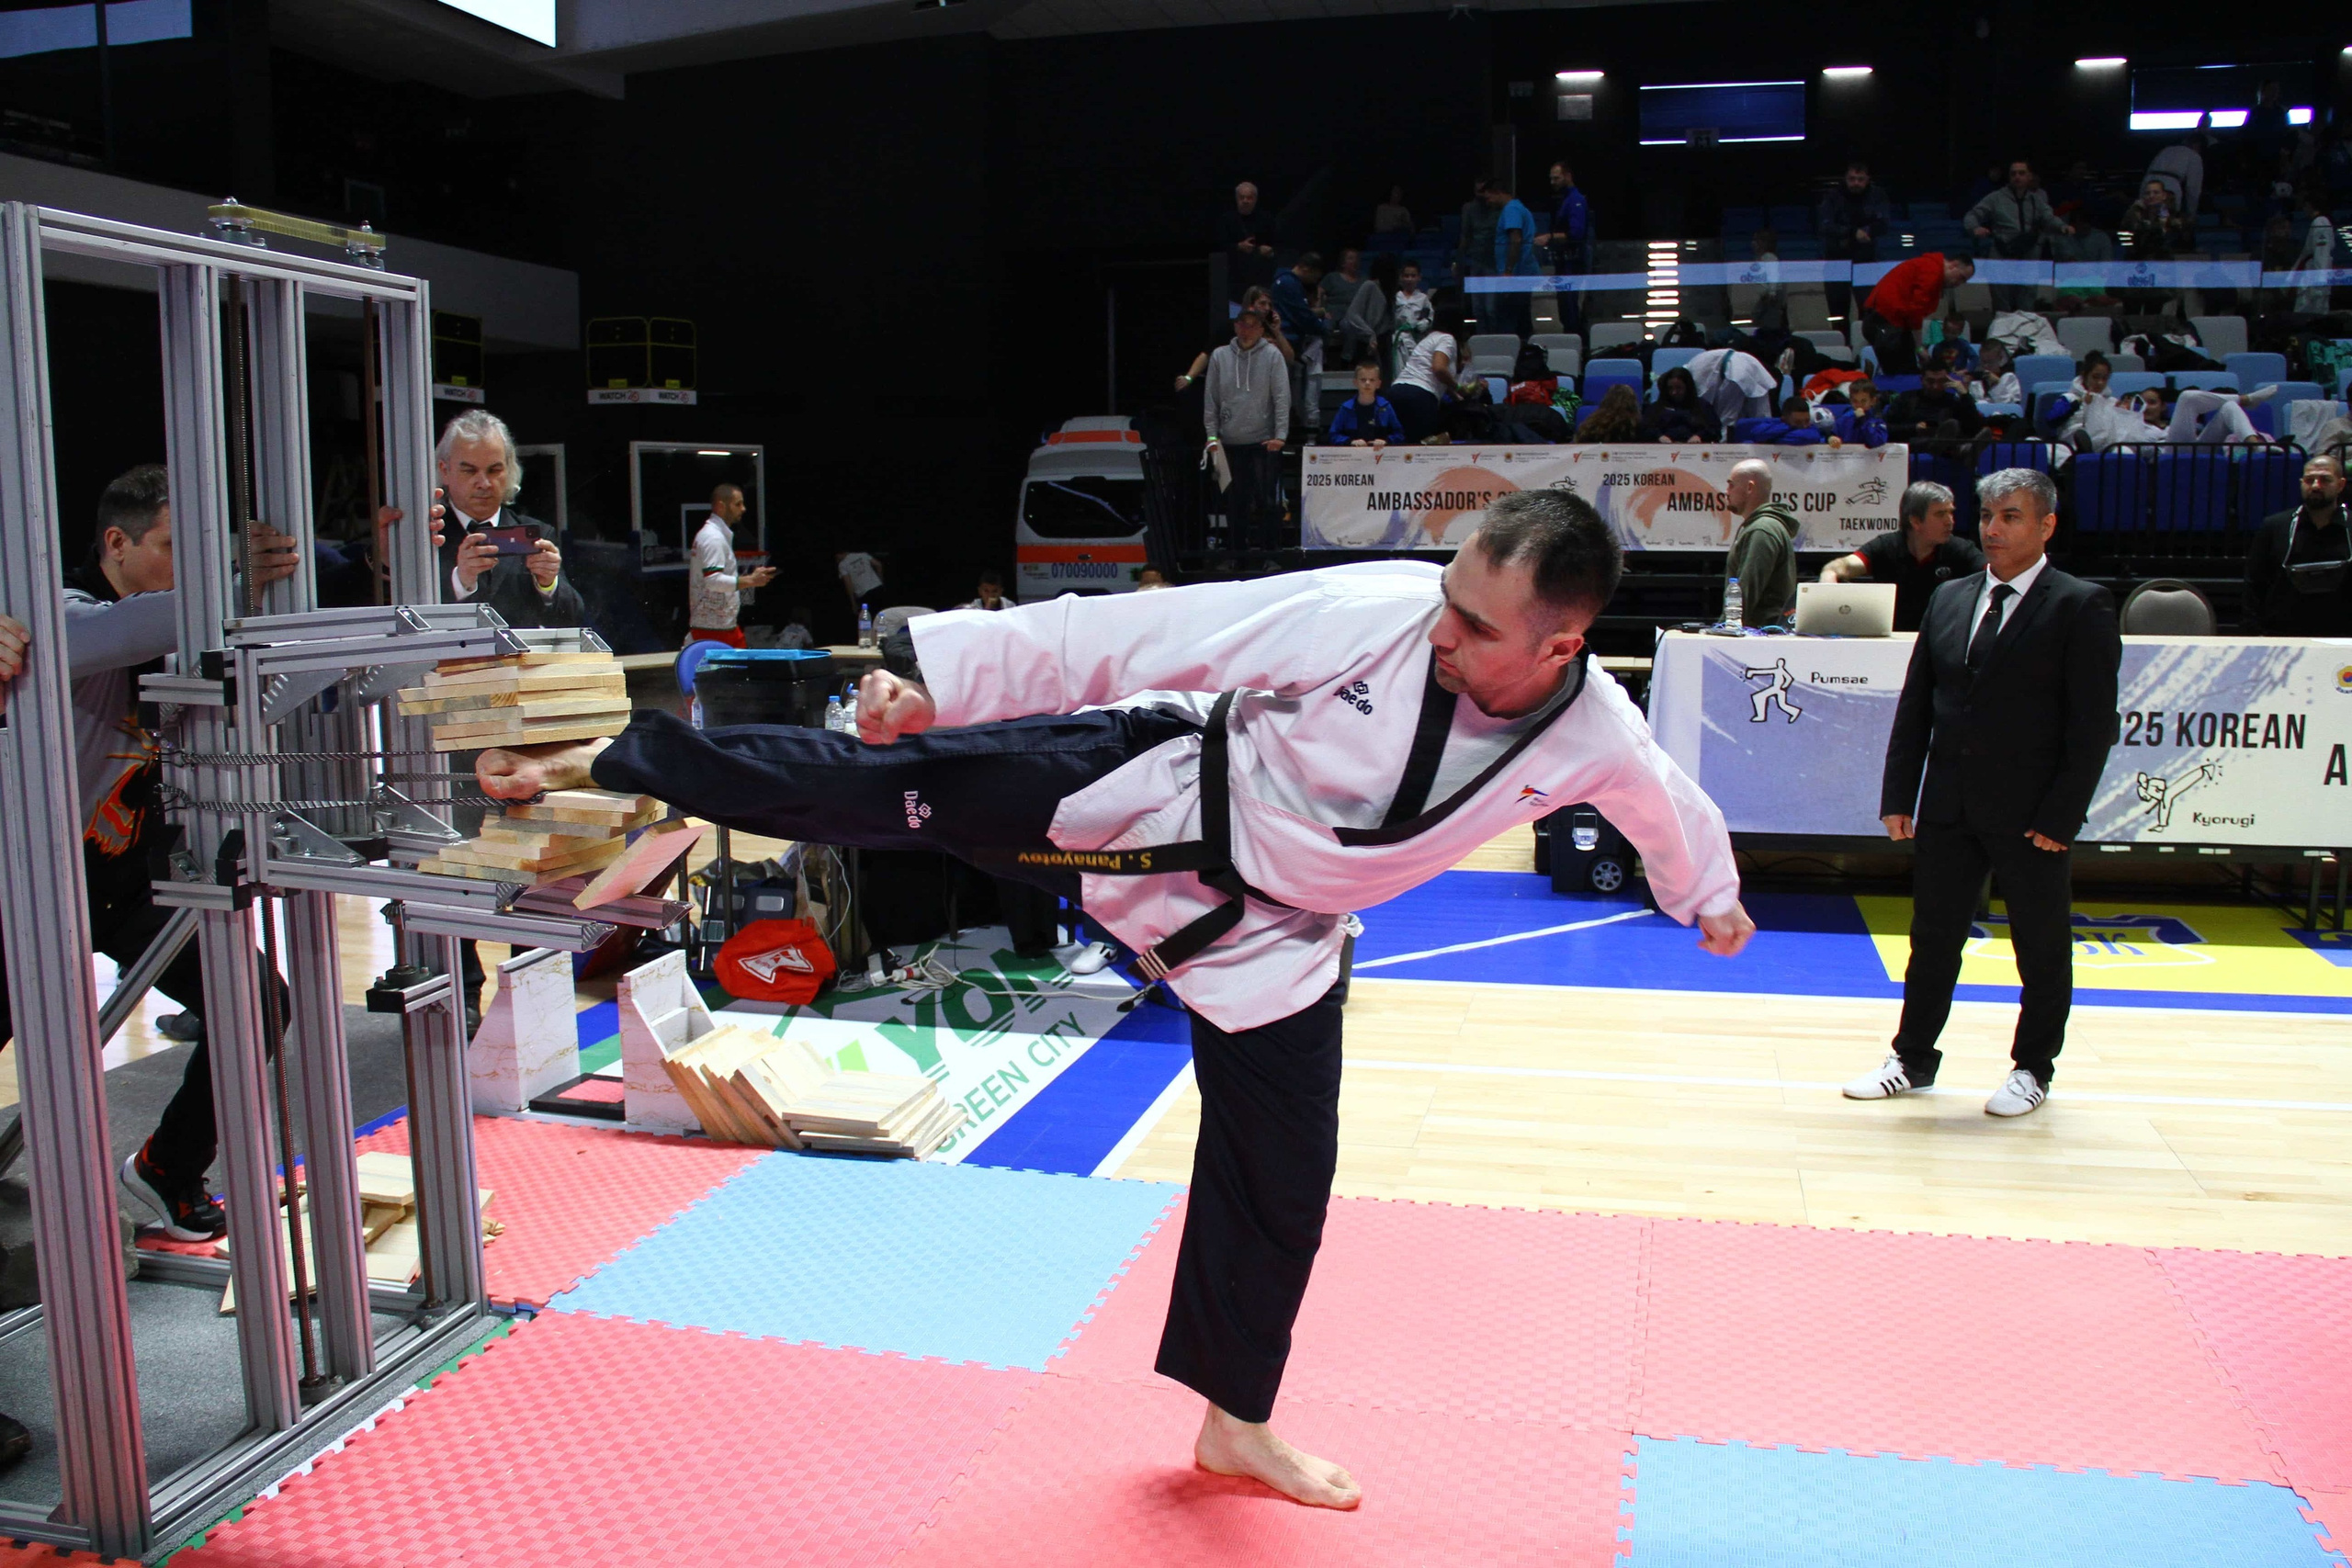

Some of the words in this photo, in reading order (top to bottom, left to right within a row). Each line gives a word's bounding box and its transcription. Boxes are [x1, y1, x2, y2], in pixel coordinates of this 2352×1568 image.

[598, 391, 626, 400] WATCH
[1306, 474, 1331, 487] 2025
[1334, 474, 1374, 487] KOREAN
[1603, 473, 1630, 486] 2025
[1634, 473, 1676, 486] KOREAN
[1367, 491, 1491, 511] AMBASSADOR'S
[1804, 492, 1837, 513] CUP
[1051, 562, 1119, 579] 070090000
[1810, 671, 1869, 685] Pumsae
[2112, 711, 2164, 748] 25
[2175, 712, 2307, 750] KOREAN
[903, 790, 923, 829] Daedo
[2192, 811, 2256, 828] Kyorugi
[1017, 851, 1122, 871] Panayotov
[1026, 1010, 1087, 1068] CITY
